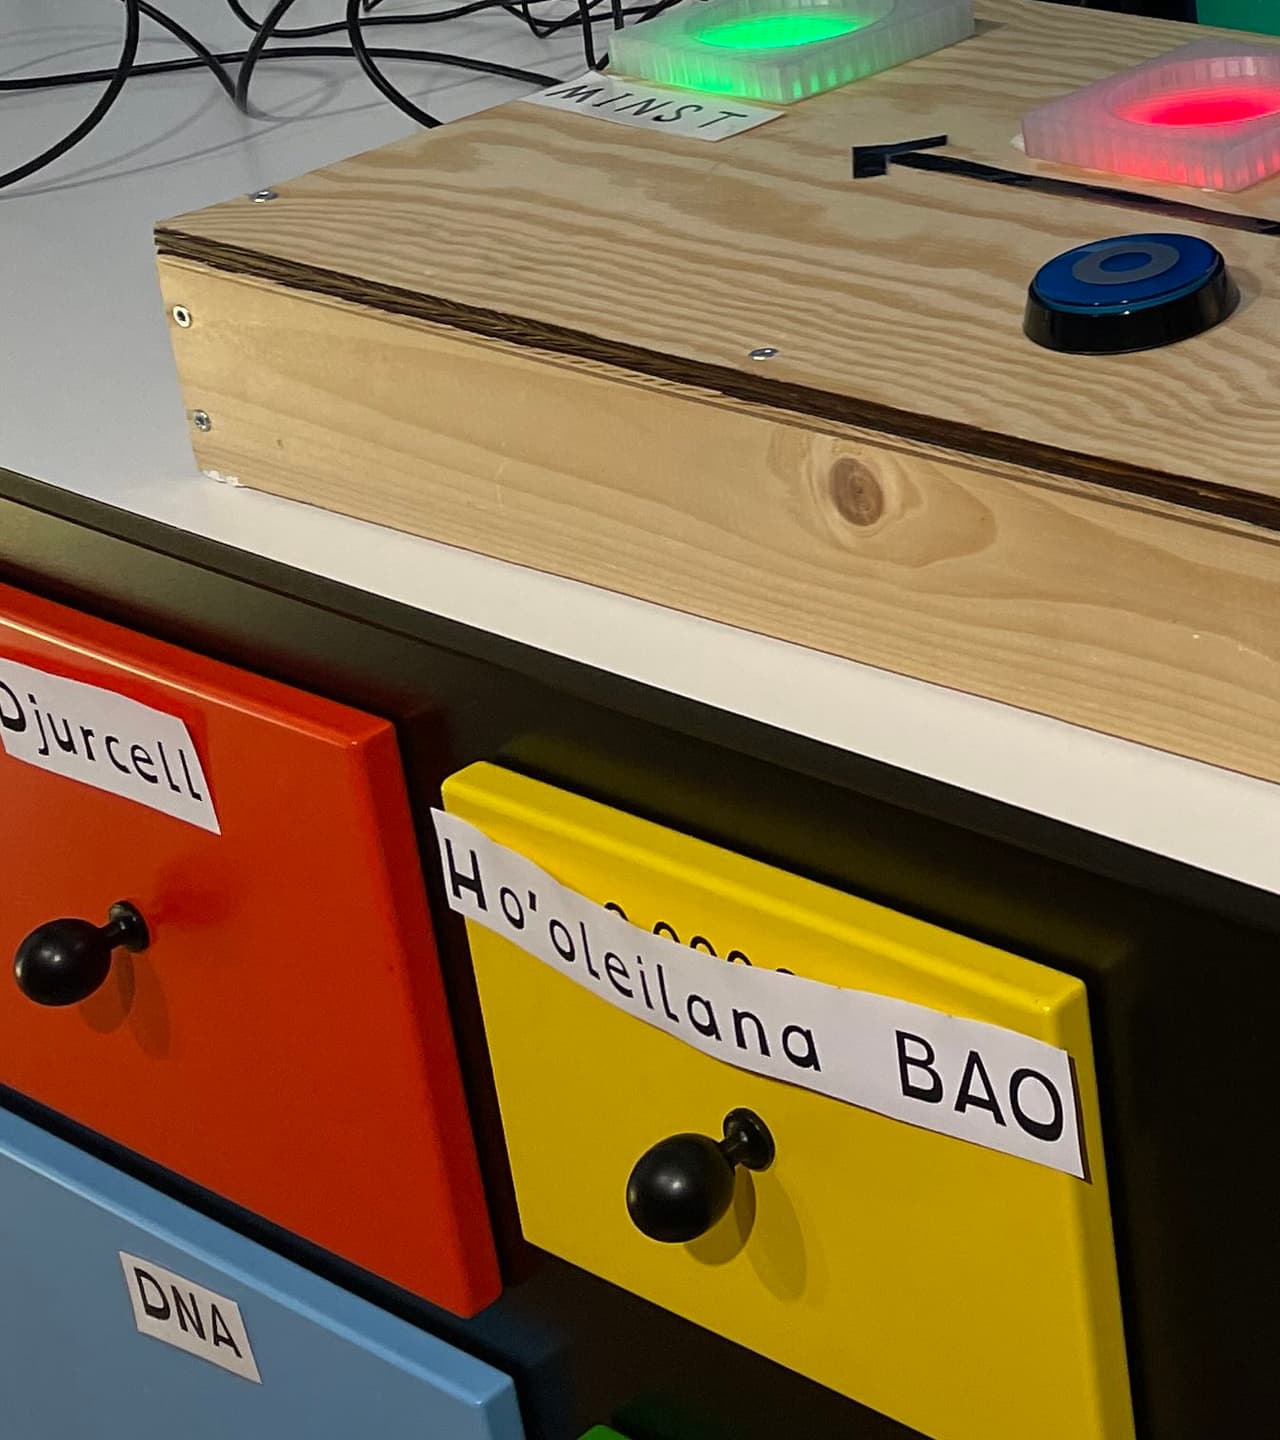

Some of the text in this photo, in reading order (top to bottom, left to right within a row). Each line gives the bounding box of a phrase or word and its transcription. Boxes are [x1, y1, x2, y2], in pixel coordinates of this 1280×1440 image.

[545, 84, 748, 129] MINST
[444, 837, 822, 1073] Ho'oleilana
[895, 1029, 1064, 1142] BAO
[134, 1268, 243, 1358] DNA
